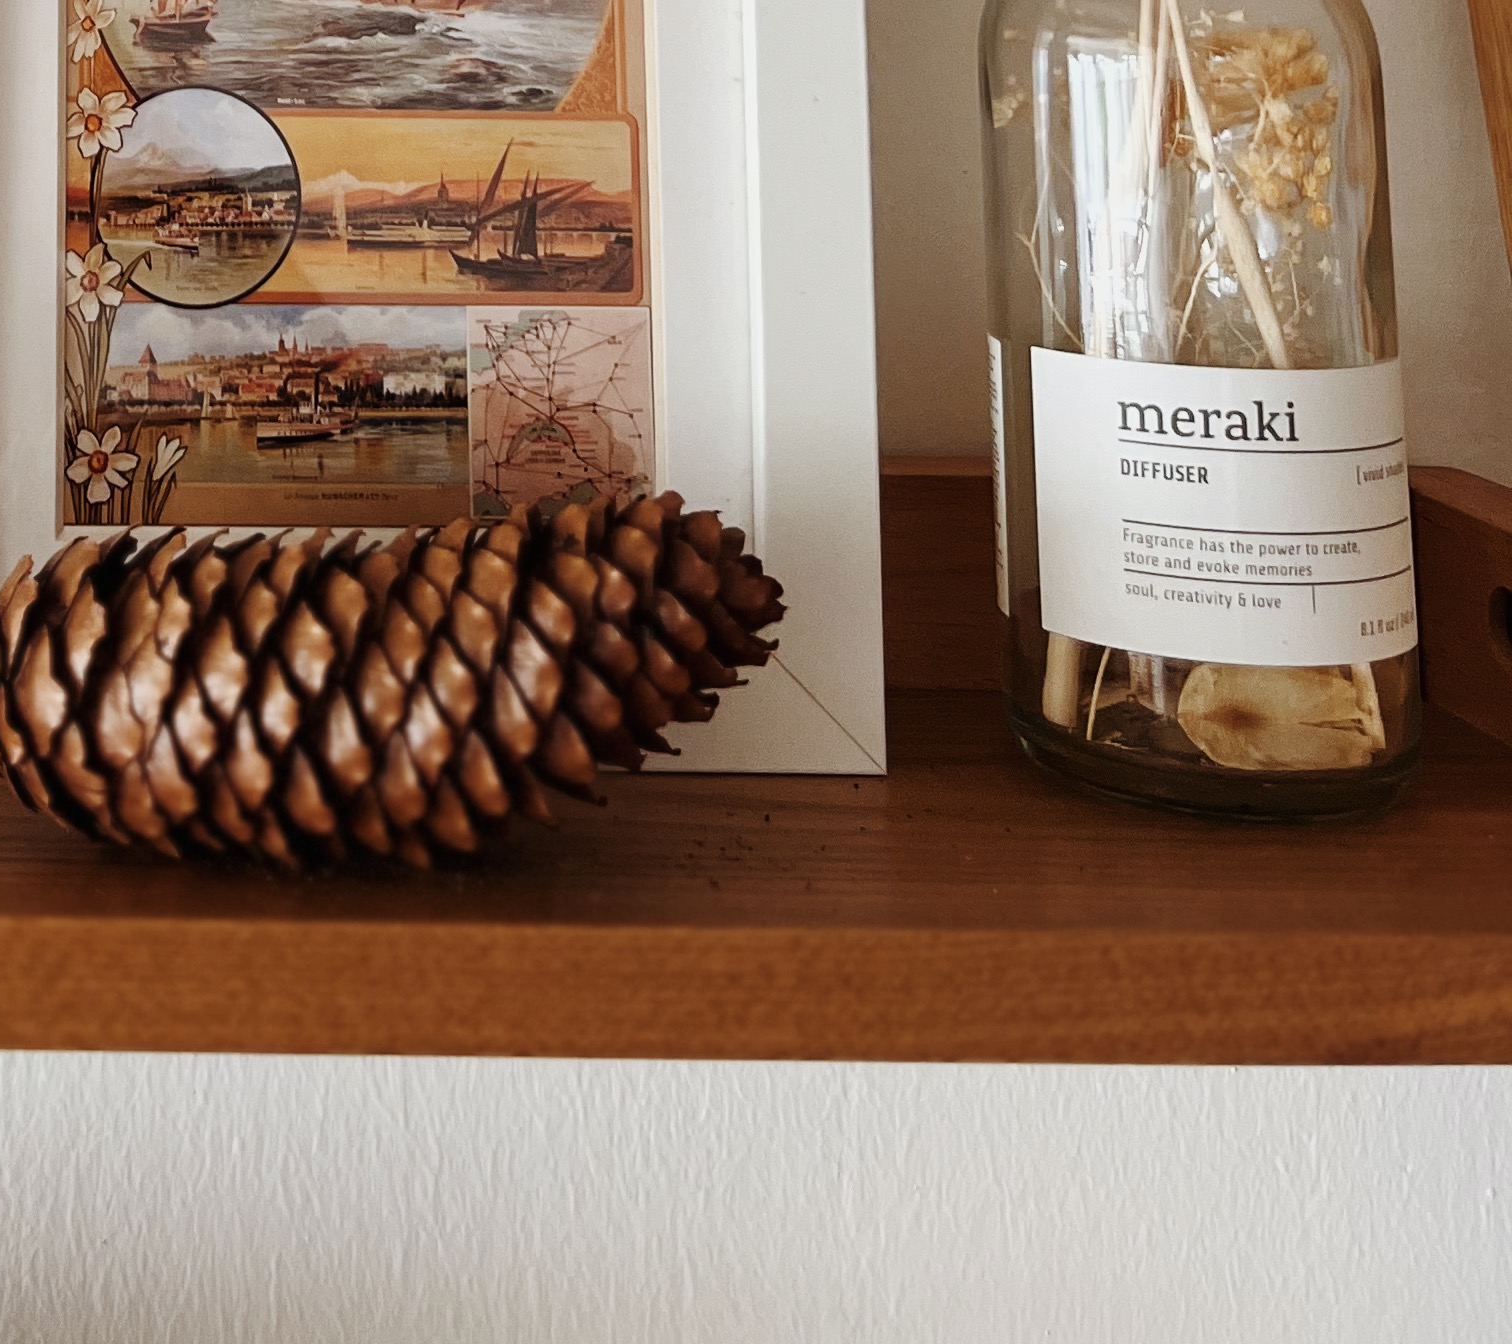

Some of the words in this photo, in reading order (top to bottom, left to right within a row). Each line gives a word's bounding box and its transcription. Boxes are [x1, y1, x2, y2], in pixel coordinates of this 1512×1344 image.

[1117, 400, 1300, 442] meraki
[1119, 458, 1209, 485] DIFFUSER
[1122, 527, 1194, 550] Fragrance
[1199, 537, 1225, 553] has
[1230, 539, 1254, 555] the
[1259, 542, 1302, 557] power
[1306, 541, 1319, 556] to
[1323, 540, 1361, 555] create,
[1123, 551, 1159, 567] store
[1164, 556, 1191, 571] and
[1197, 558, 1240, 575] evoke
[1245, 563, 1313, 577] memories
[1125, 581, 1159, 601] soul,
[1163, 585, 1233, 610] creativity
[1238, 592, 1247, 608] &
[1252, 593, 1282, 609] love
